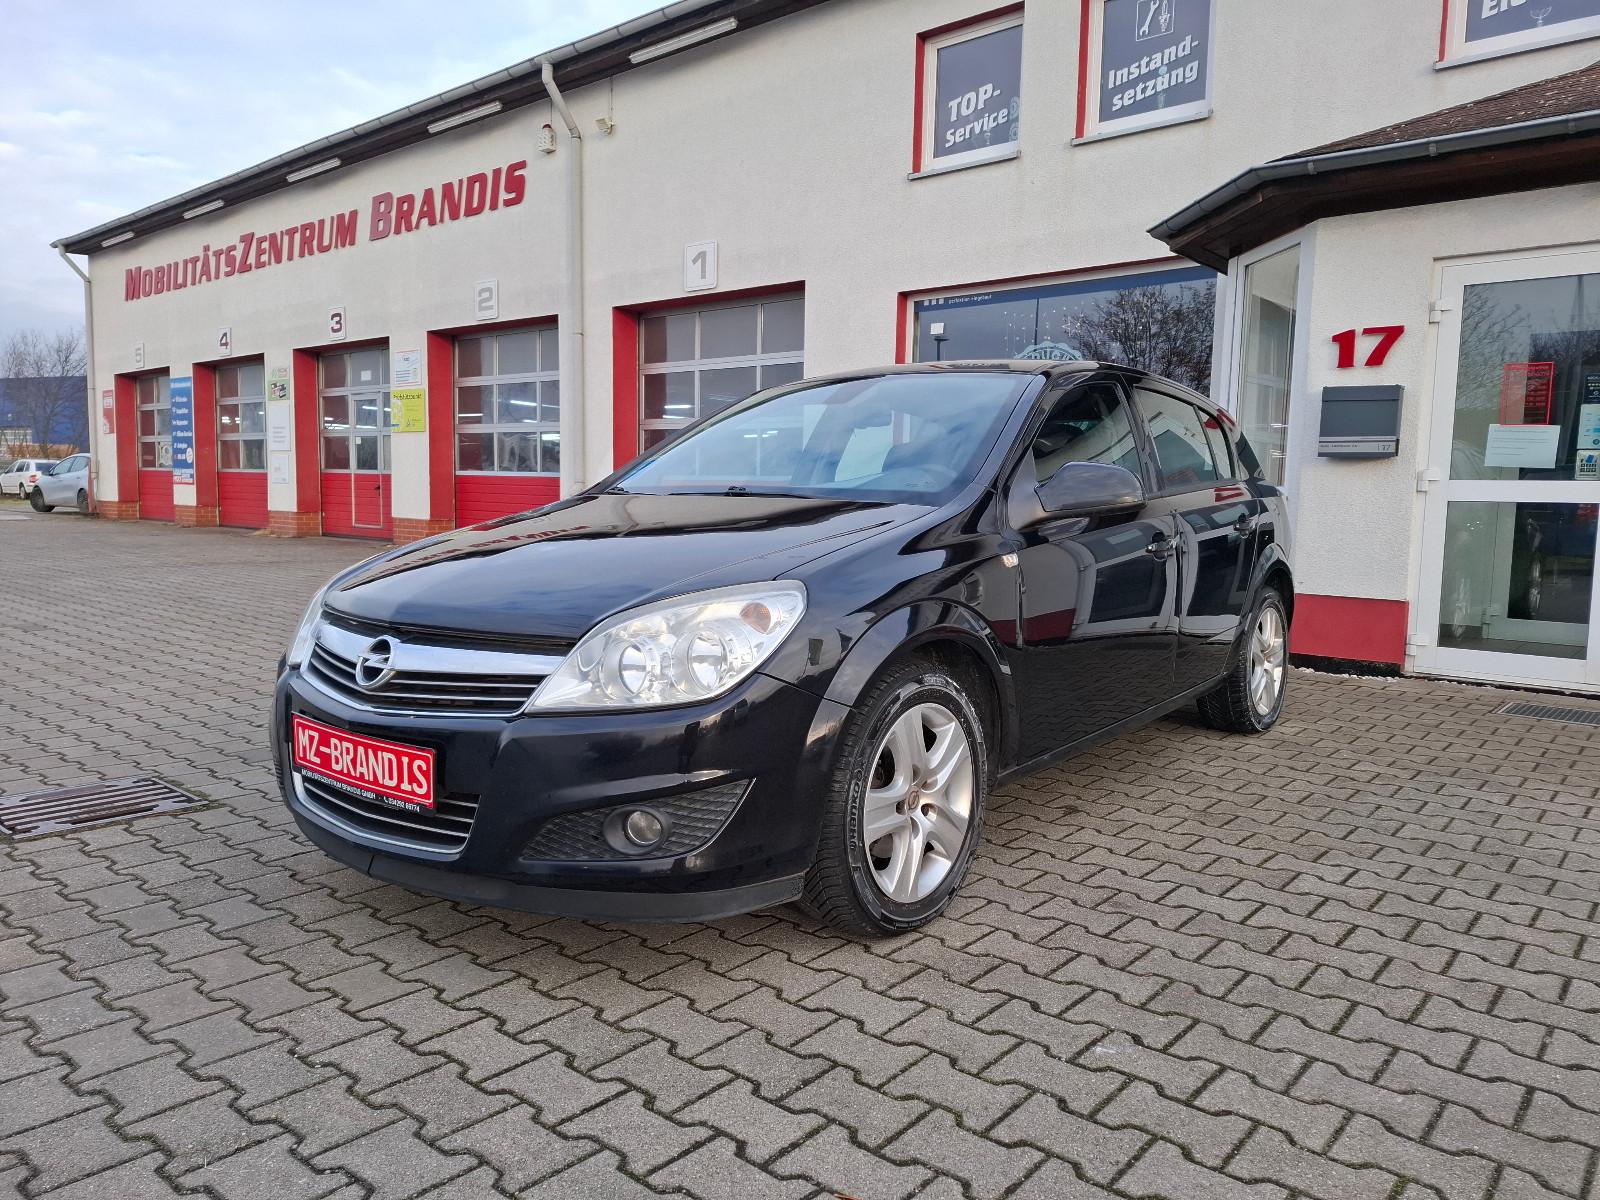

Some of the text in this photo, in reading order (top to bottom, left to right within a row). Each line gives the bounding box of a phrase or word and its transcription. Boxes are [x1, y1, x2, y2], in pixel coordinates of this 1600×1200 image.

[1108, 34, 1199, 89] Instand-
[948, 83, 1001, 122] TOP-
[1112, 60, 1199, 112] setzung
[945, 108, 1009, 148] Service
[691, 250, 707, 280] 1
[478, 286, 494, 312] 2
[219, 331, 230, 349] 4
[330, 312, 343, 333] 3
[1331, 325, 1405, 369] 17
[297, 726, 428, 796] MZ-BRANDIS
